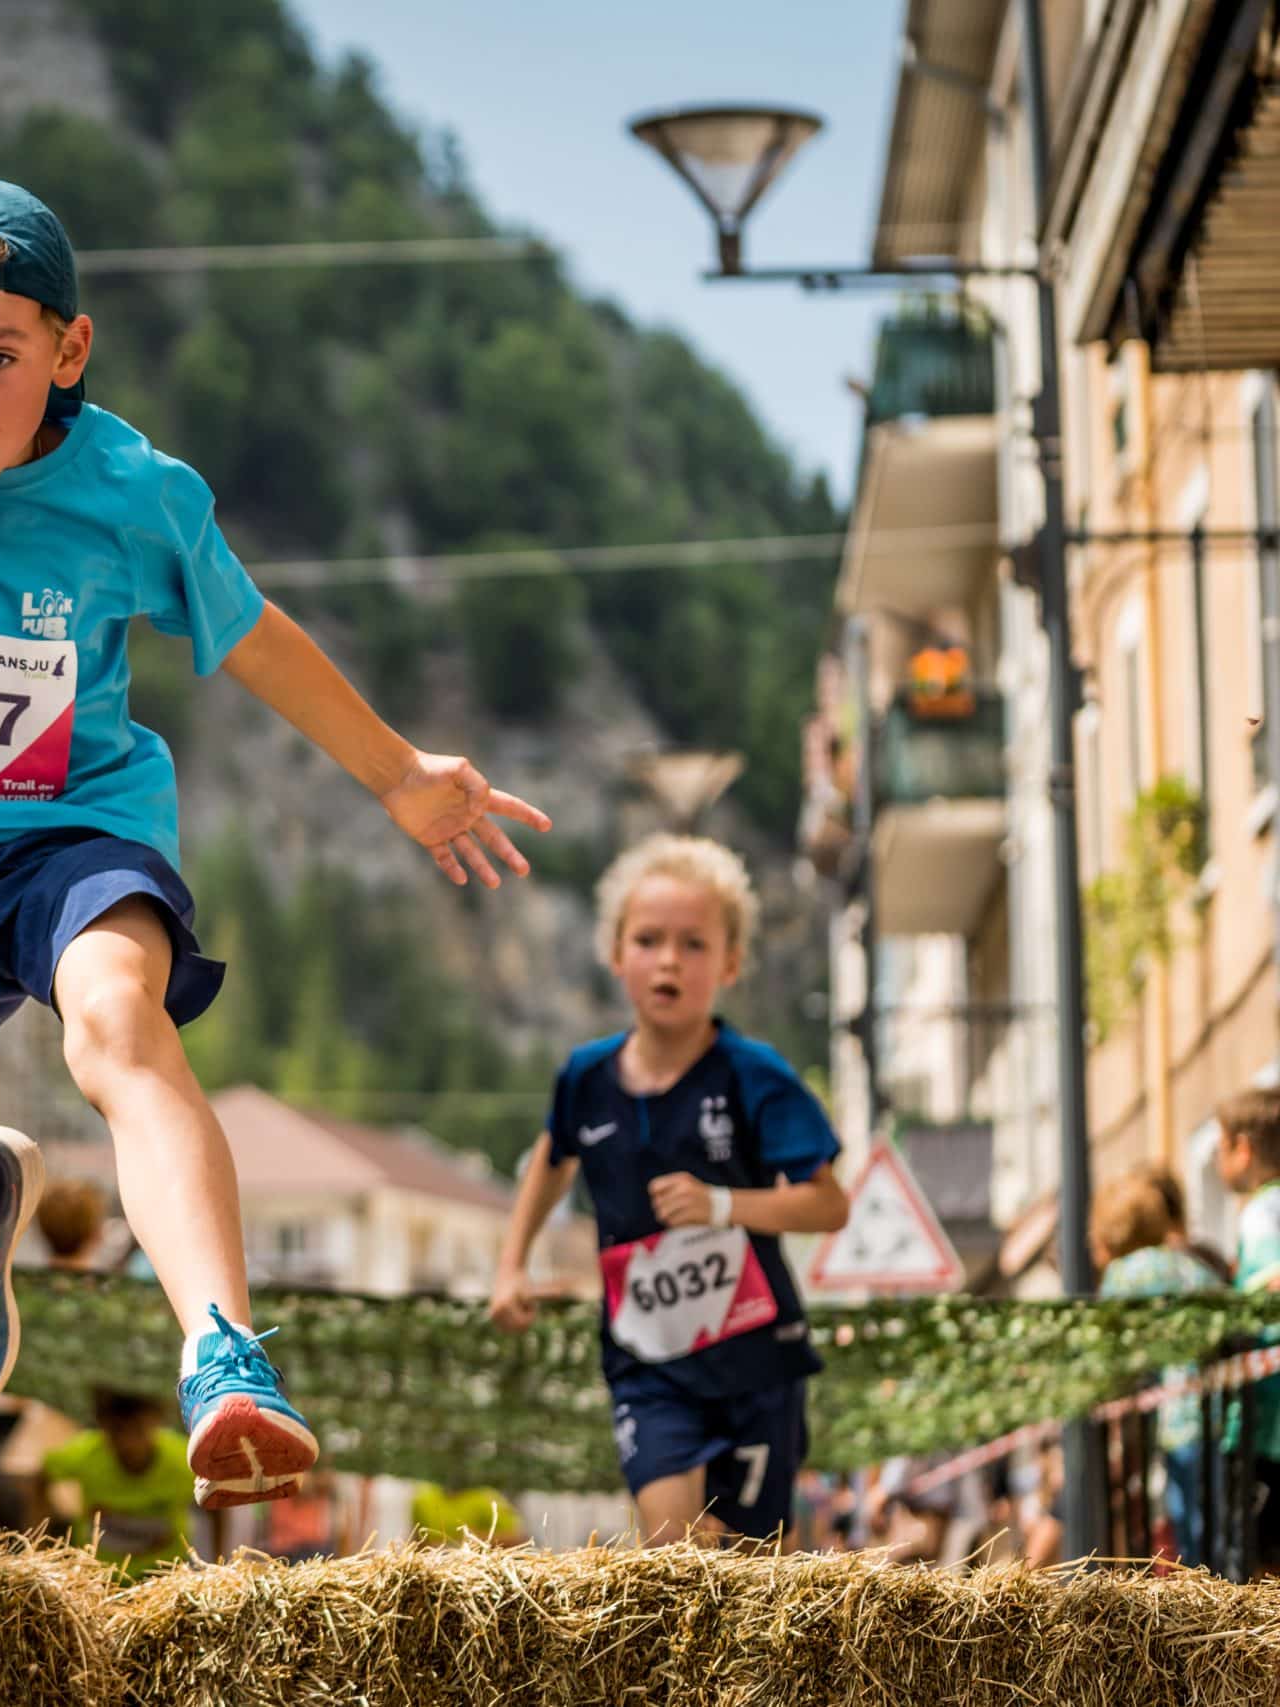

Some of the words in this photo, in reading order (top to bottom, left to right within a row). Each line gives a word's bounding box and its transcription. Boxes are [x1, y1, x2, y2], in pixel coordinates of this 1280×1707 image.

[2, 779, 36, 791] Trail
[631, 1252, 736, 1313] 6032
[735, 1444, 770, 1508] 7
